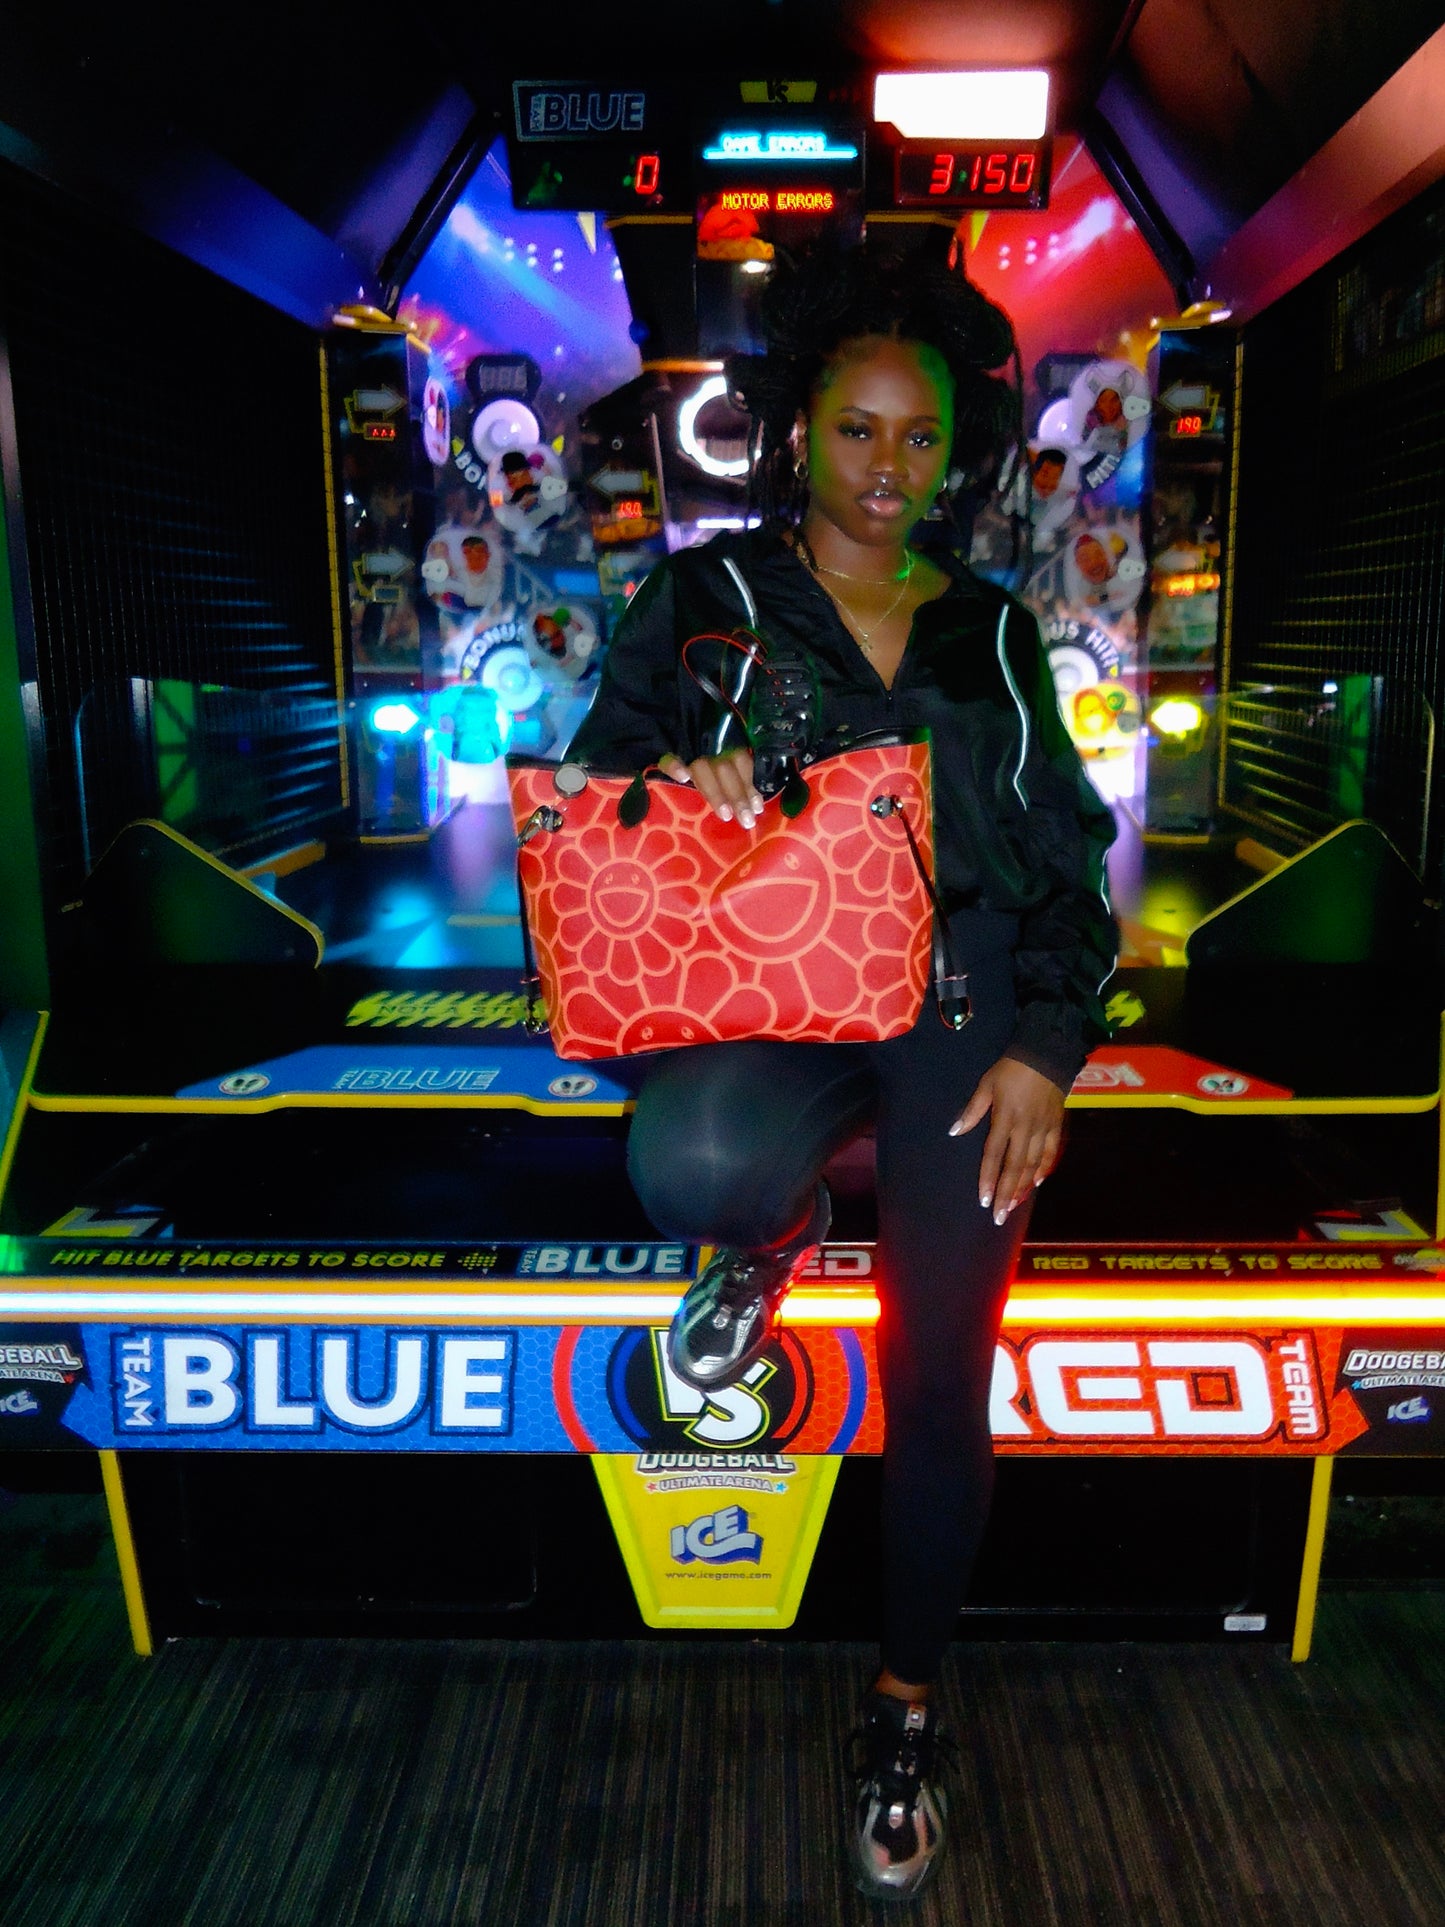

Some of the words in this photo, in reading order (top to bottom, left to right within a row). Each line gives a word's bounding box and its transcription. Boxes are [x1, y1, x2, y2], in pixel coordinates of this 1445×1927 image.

[545, 93, 645, 131] BLUE
[634, 155, 660, 194] 0
[929, 154, 1035, 194] 3150
[722, 192, 769, 210] MOTOR
[775, 192, 834, 210] ERRORS
[348, 1070, 500, 1090] BLUE
[50, 1251, 102, 1265] HIT
[103, 1252, 174, 1266] BLUE
[180, 1252, 301, 1267] TARGETS
[308, 1252, 344, 1267] TO
[355, 1252, 446, 1268] SCORE
[520, 1249, 538, 1273] TEAM
[535, 1248, 685, 1274] BLUE
[1032, 1256, 1090, 1270] RED
[1100, 1255, 1231, 1271] TARGETS
[1239, 1255, 1279, 1270] TO
[1287, 1255, 1383, 1271] SCORE
[1347, 1352, 1445, 1371] DODGEB
[122, 1337, 152, 1427] TEAM
[164, 1339, 506, 1428] BLUE
[1280, 1339, 1317, 1435] TEAM
[1387, 1397, 1430, 1421] ICE
[638, 1454, 795, 1472] DODGEBALL
[659, 1475, 724, 1491] ULTIMATE
[725, 1475, 774, 1492] ARENA
[671, 1504, 764, 1565] ICE
[665, 1571, 772, 1581] www.icegame.com
